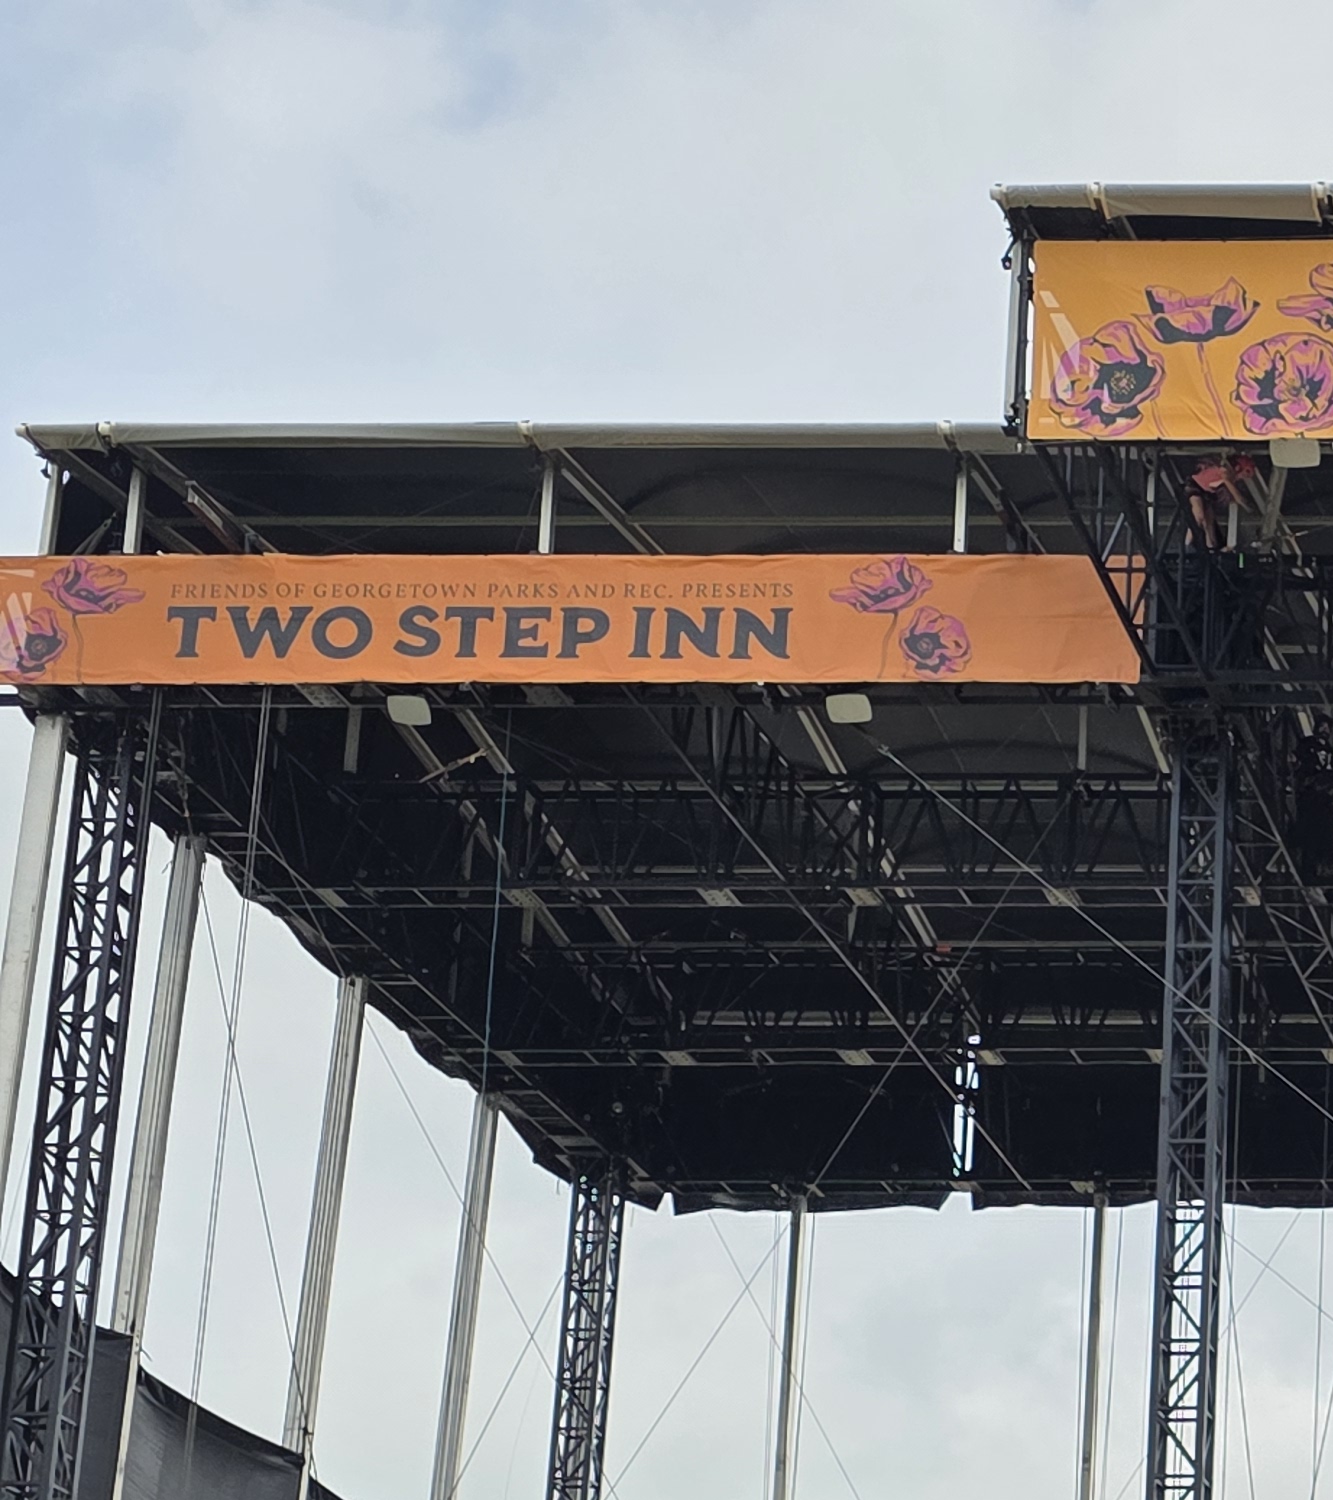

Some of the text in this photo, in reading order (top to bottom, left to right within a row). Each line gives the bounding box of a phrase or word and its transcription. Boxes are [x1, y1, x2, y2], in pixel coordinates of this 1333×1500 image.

[170, 581, 794, 599] FRIENDS OF GEORGETOWN PARKS AND REC. PRESENTS
[167, 605, 791, 660] TWO STEP INN
